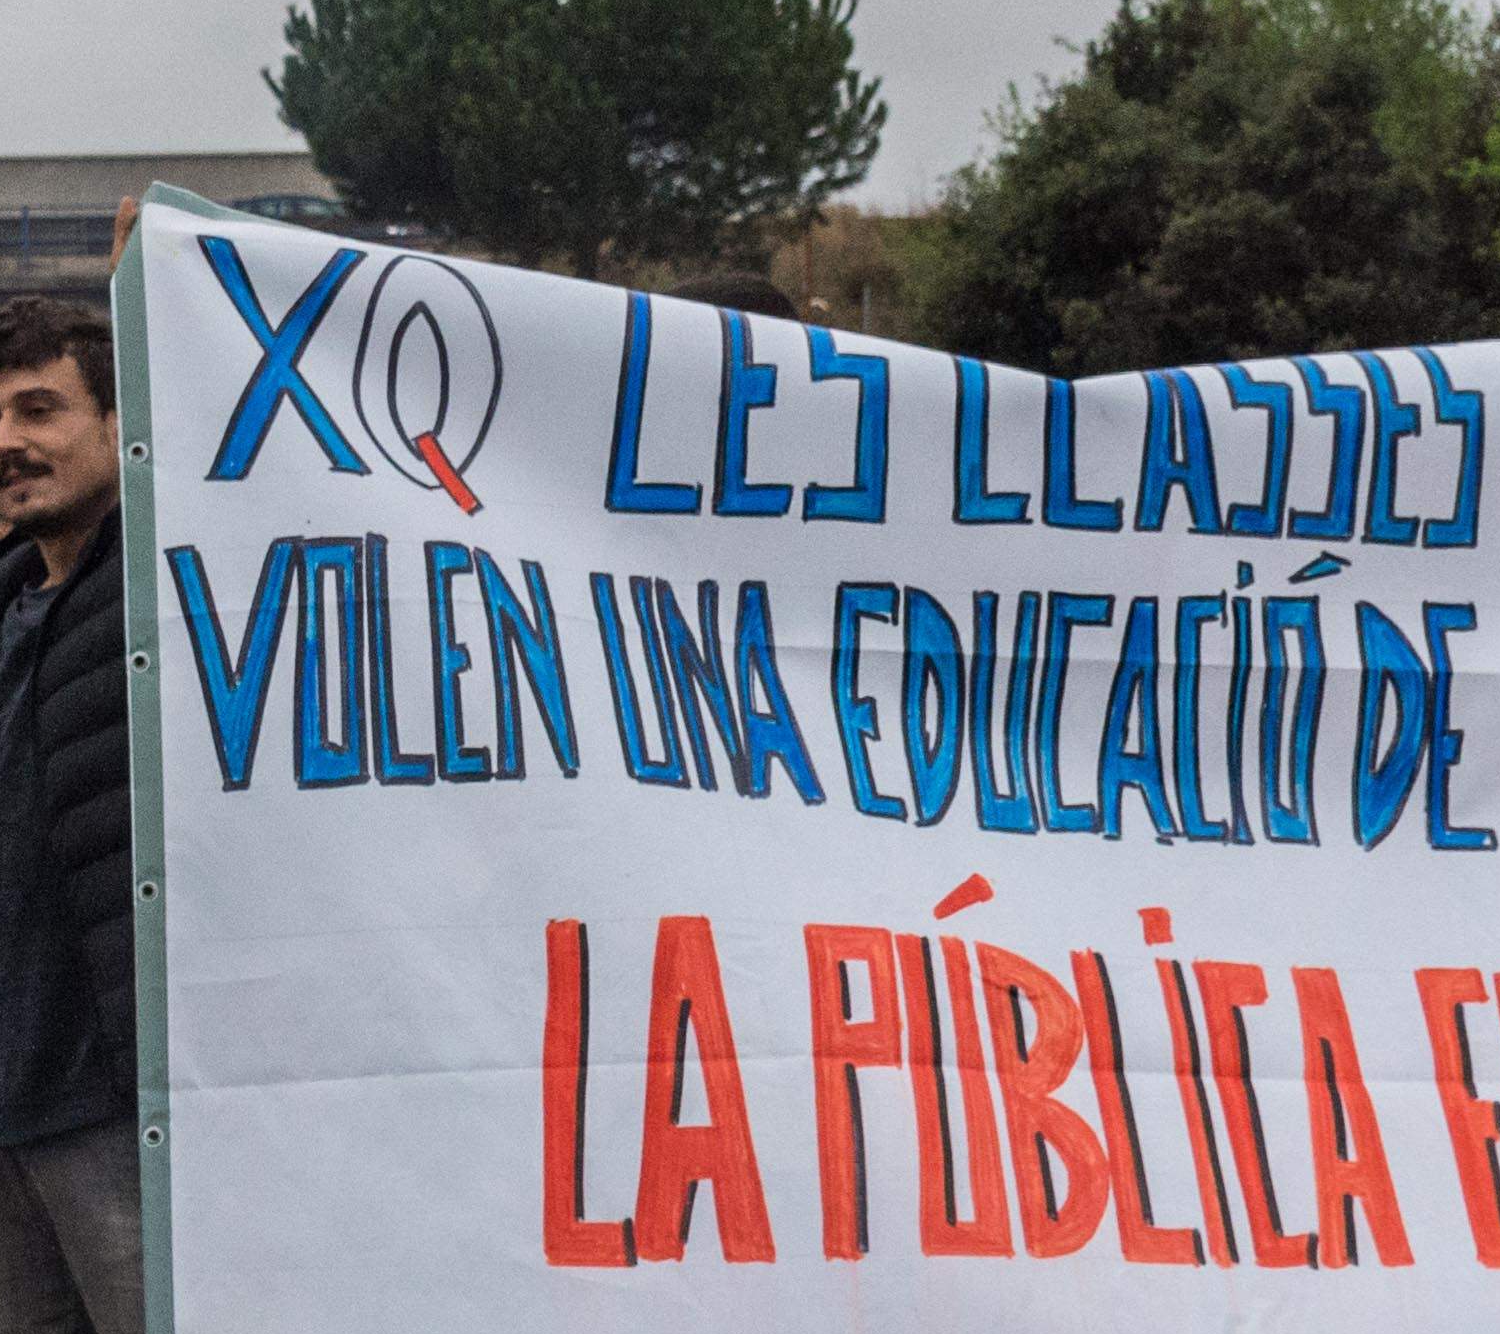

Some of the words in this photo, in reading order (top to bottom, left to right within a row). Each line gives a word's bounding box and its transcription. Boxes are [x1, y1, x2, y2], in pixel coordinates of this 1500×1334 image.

[197, 232, 504, 517] XQ
[602, 287, 890, 525] LES
[164, 531, 582, 794] VOLEN
[588, 567, 827, 807] UNA
[1353, 597, 1500, 853] DE
[541, 912, 779, 1270] LA
[805, 873, 1417, 1275] PÚBLICA
